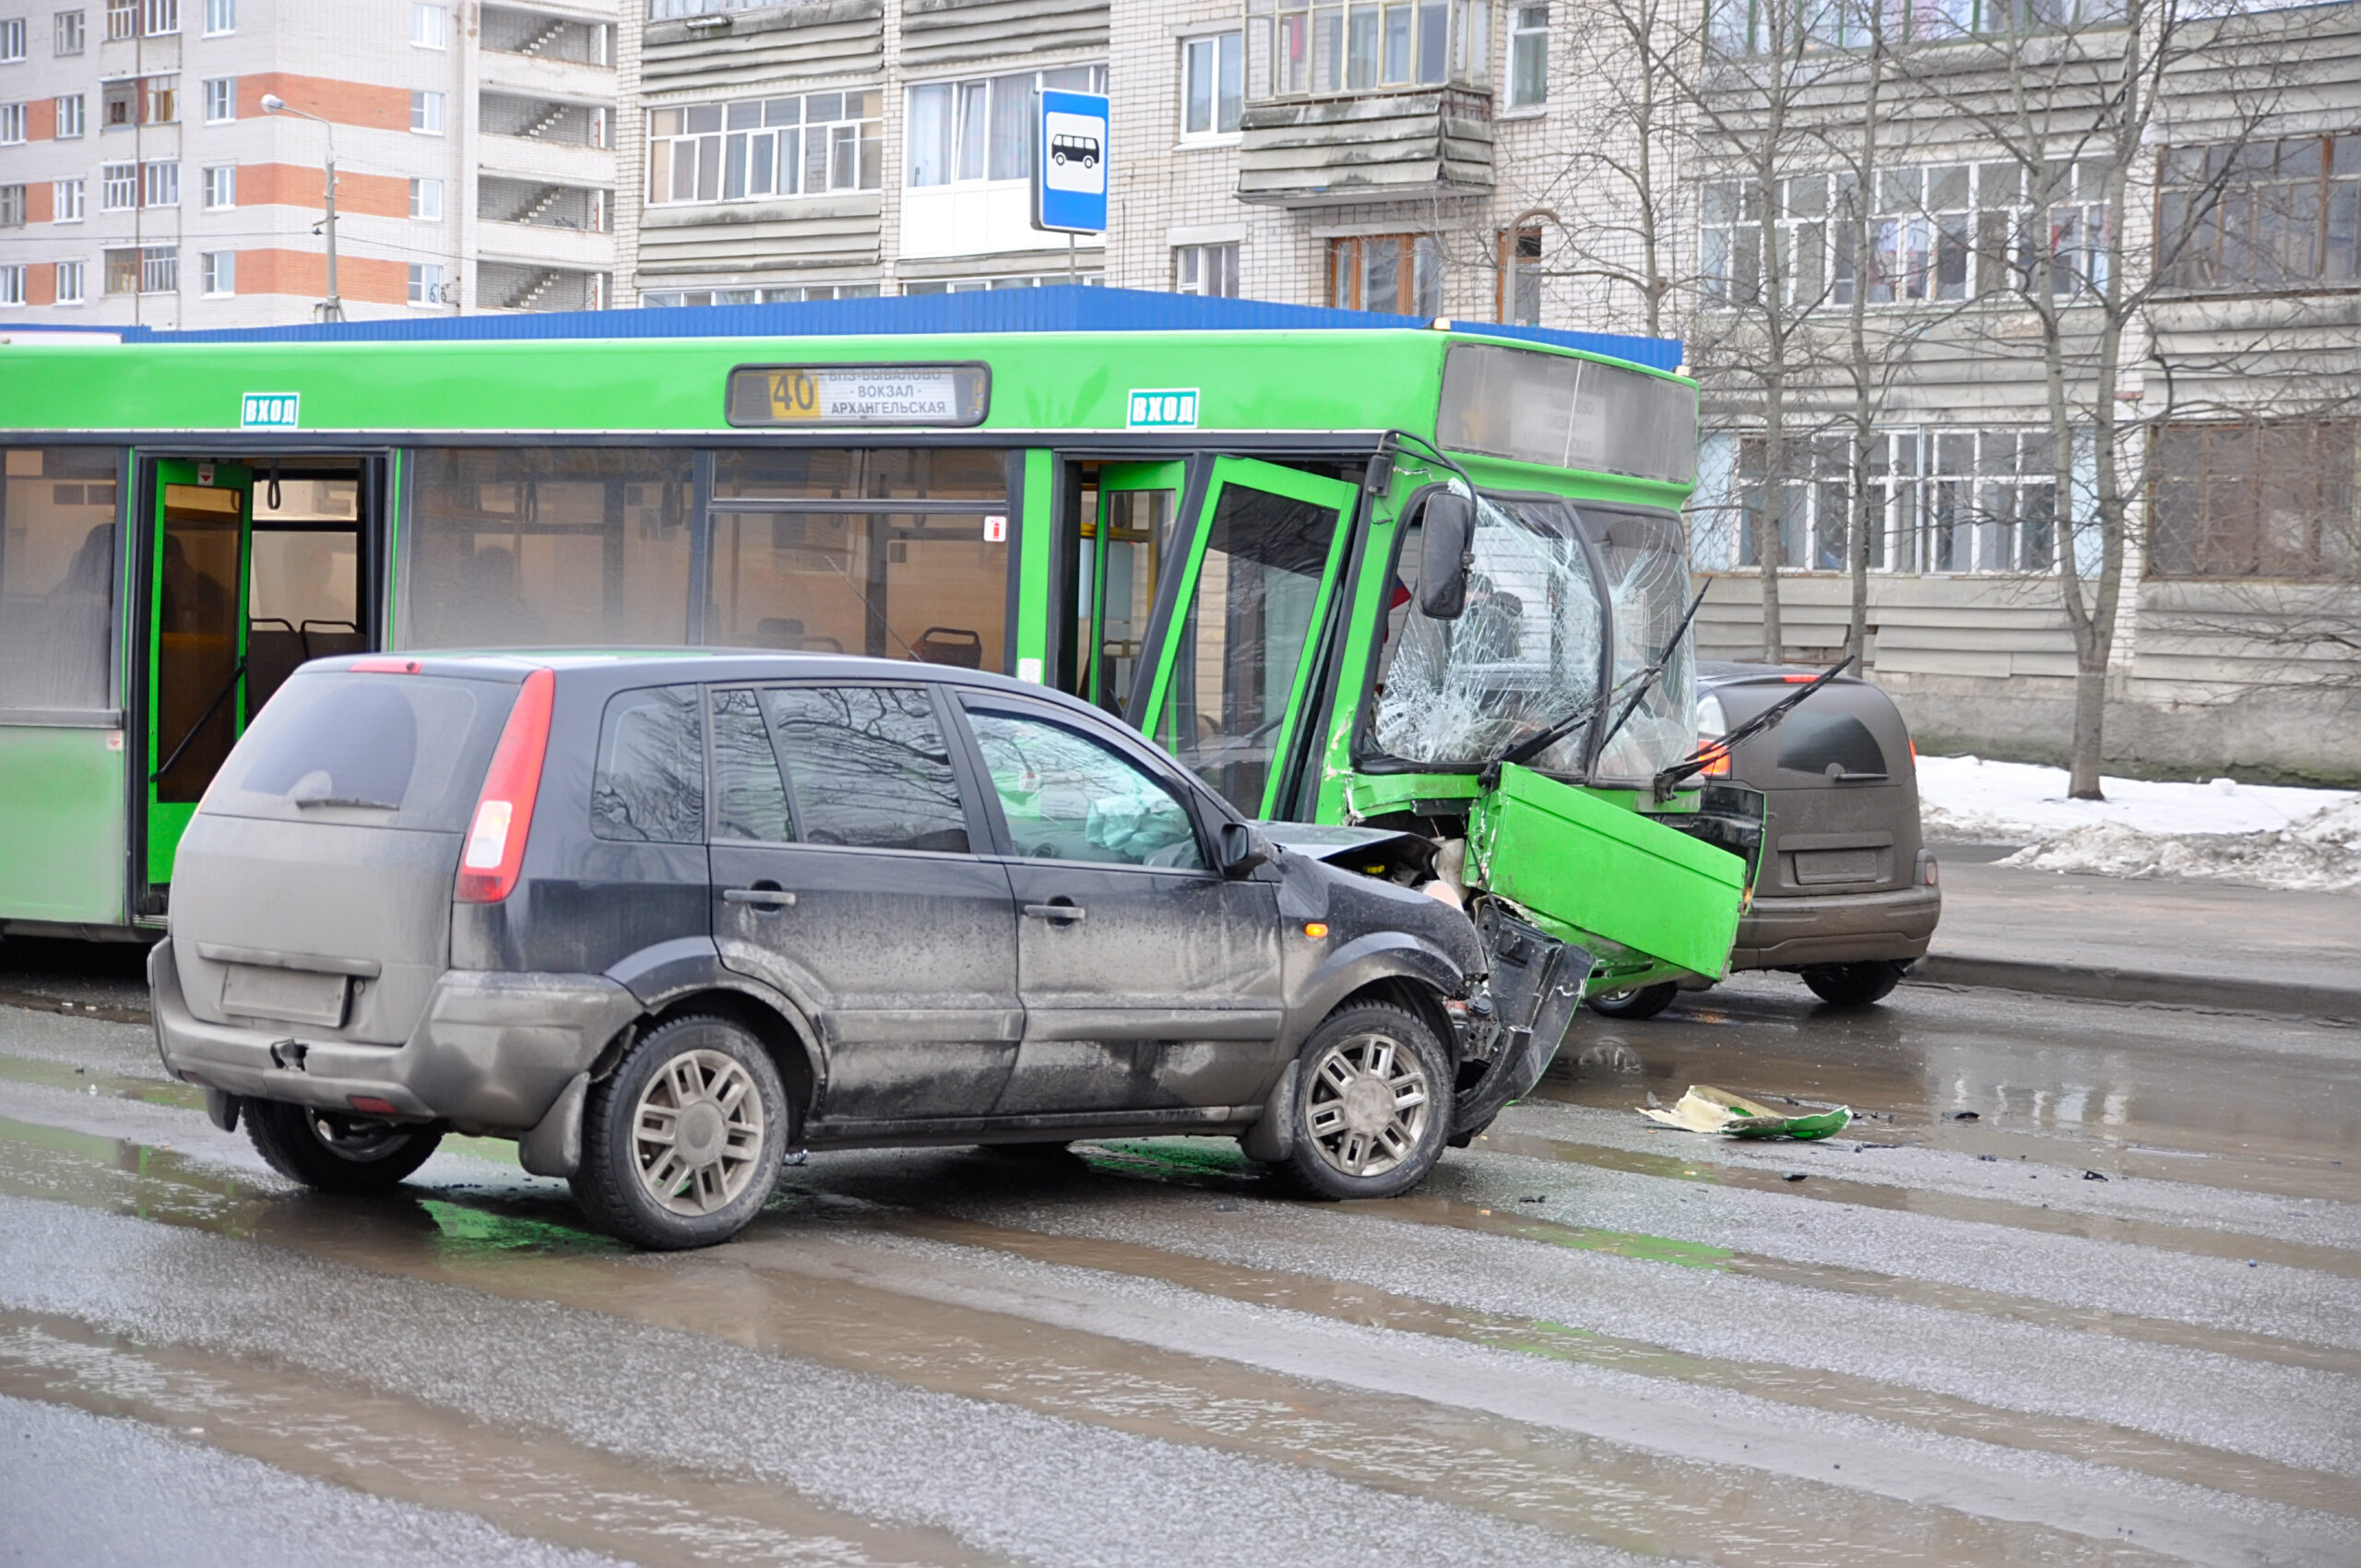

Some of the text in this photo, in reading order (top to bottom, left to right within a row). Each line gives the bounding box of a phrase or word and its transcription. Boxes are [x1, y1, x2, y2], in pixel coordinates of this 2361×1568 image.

[773, 373, 814, 410] 40
[858, 385, 914, 398] ВОКЗАЛ
[245, 398, 296, 423] ВХОД
[831, 401, 946, 414] АРХАНГЕЛЬСКАЯ
[1132, 396, 1194, 422] ВХОД
